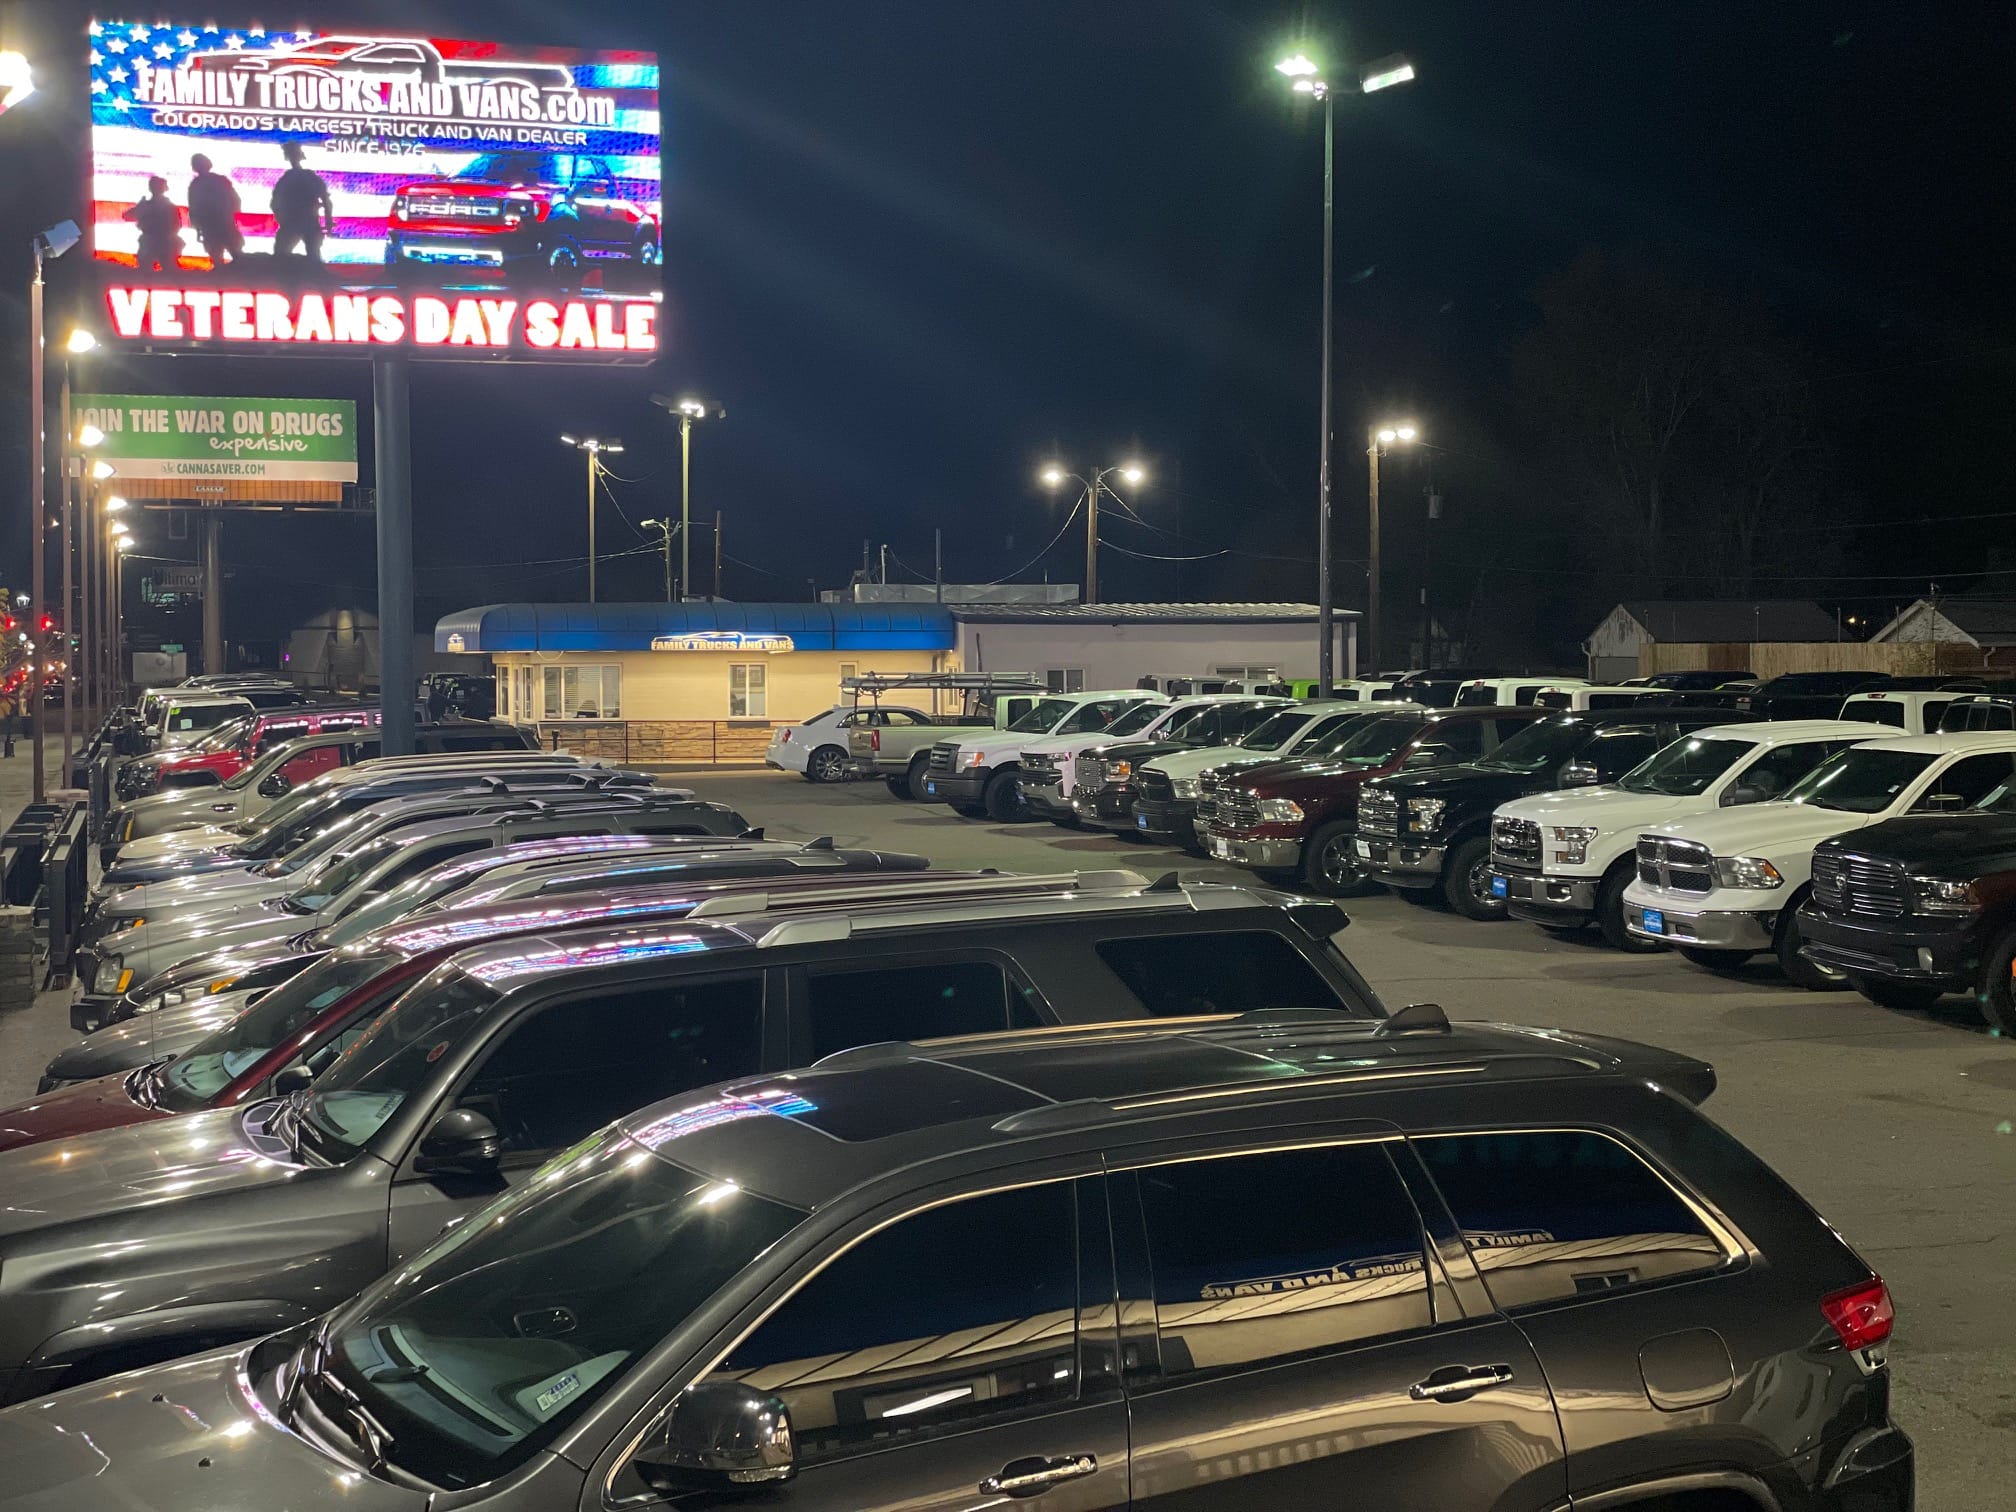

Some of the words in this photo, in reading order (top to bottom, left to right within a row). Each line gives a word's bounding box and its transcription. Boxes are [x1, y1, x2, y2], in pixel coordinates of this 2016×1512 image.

[139, 68, 250, 106] FAMILY
[255, 74, 383, 114] TRUCKS
[389, 81, 452, 116] AND
[459, 84, 616, 125] VANS.com
[151, 111, 274, 131] COLORADO'S
[278, 116, 367, 134] LARGEST
[370, 121, 429, 138] TRUCK
[433, 126, 472, 139] AND
[475, 127, 512, 142] VAN
[517, 129, 588, 146] DEALER
[108, 287, 405, 342] VETERANS
[413, 297, 517, 345] DAY
[525, 301, 657, 349] SALE
[129, 408, 169, 432] THE
[174, 410, 225, 433] WAR
[233, 411, 264, 434] ON
[271, 412, 343, 436] DRUGS
[209, 433, 308, 457] expensive
[177, 463, 266, 475] CANNASAVER.COM
[651, 641, 690, 651] FAMILY
[693, 641, 738, 651] TRUCKS
[739, 641, 763, 651] AND
[765, 641, 794, 651] VANS
